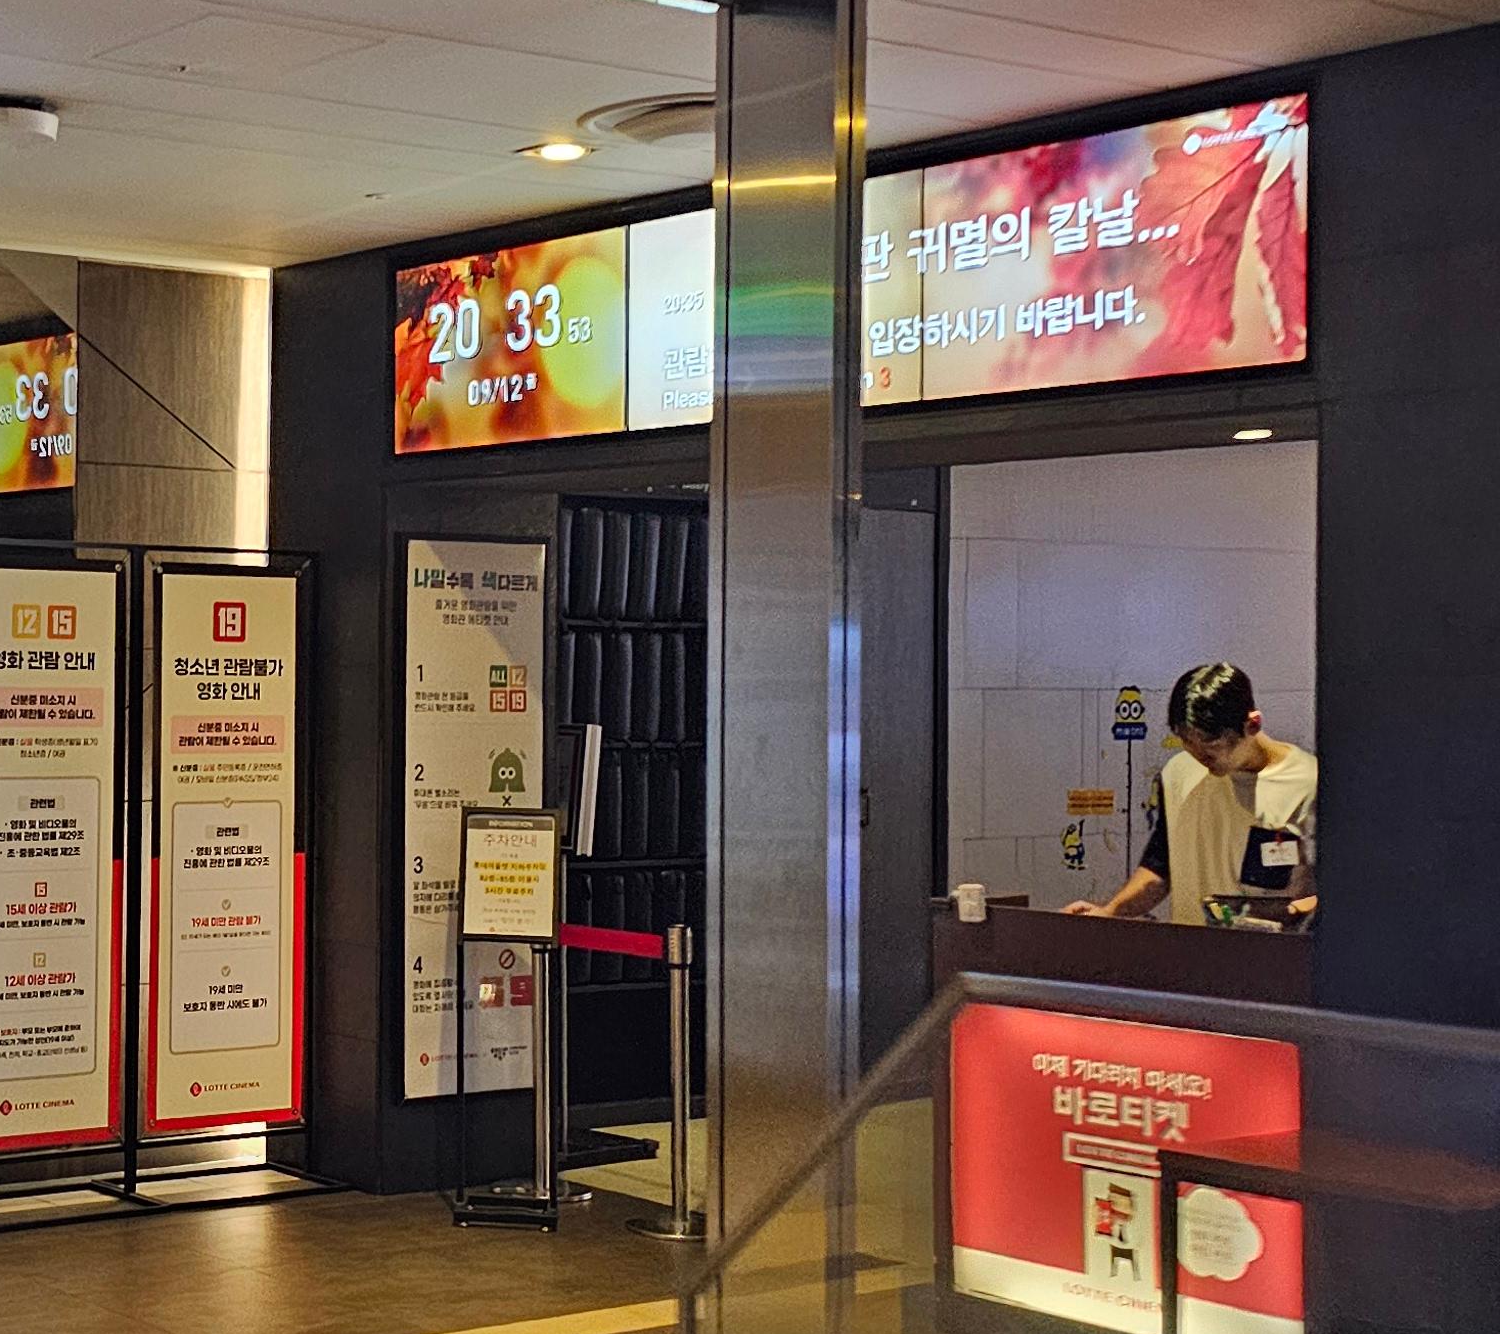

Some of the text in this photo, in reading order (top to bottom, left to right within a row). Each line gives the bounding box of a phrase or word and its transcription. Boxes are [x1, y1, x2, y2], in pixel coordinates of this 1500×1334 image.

[906, 207, 1031, 274] 귀멸의
[428, 284, 593, 364] 20 33 53
[868, 285, 1147, 357] 입장하시기 바랍니다.
[664, 346, 714, 380] 관람
[17, 609, 73, 636] 12 15
[217, 607, 242, 637] 19
[28, 651, 60, 670] 관람
[64, 652, 96, 671] 안내
[174, 657, 283, 677] 청소년 관람불가
[416, 664, 525, 686] 1 ALL 12
[10, 694, 76, 706] 신분증 미소지 시
[196, 682, 261, 701] 영화 안내
[492, 692, 505, 709] 15
[511, 692, 525, 709] 19
[48, 710, 57, 720] 수
[224, 723, 249, 733] 미소지
[250, 723, 259, 732] 시
[232, 736, 241, 746] 수
[414, 763, 424, 781] 2
[484, 833, 538, 847] 주차안내
[413, 856, 423, 874] 3
[6, 904, 26, 915] 15세
[29, 903, 47, 914] 이상
[191, 917, 209, 928] 19세
[211, 917, 226, 927] 미만
[413, 956, 423, 974] 4
[5, 976, 25, 987] 12세
[28, 974, 46, 986] 이상
[208, 985, 225, 995] 19세
[183, 1002, 208, 1012] 보호자
[227, 999, 250, 1010] 시에도
[204, 1081, 260, 1092] LOTTE CINEMA
[15, 1099, 75, 1111] LOTTE CINEMA
[1053, 1085, 1191, 1142] 바로티켓
[1062, 1280, 1114, 1304] LOTTE
